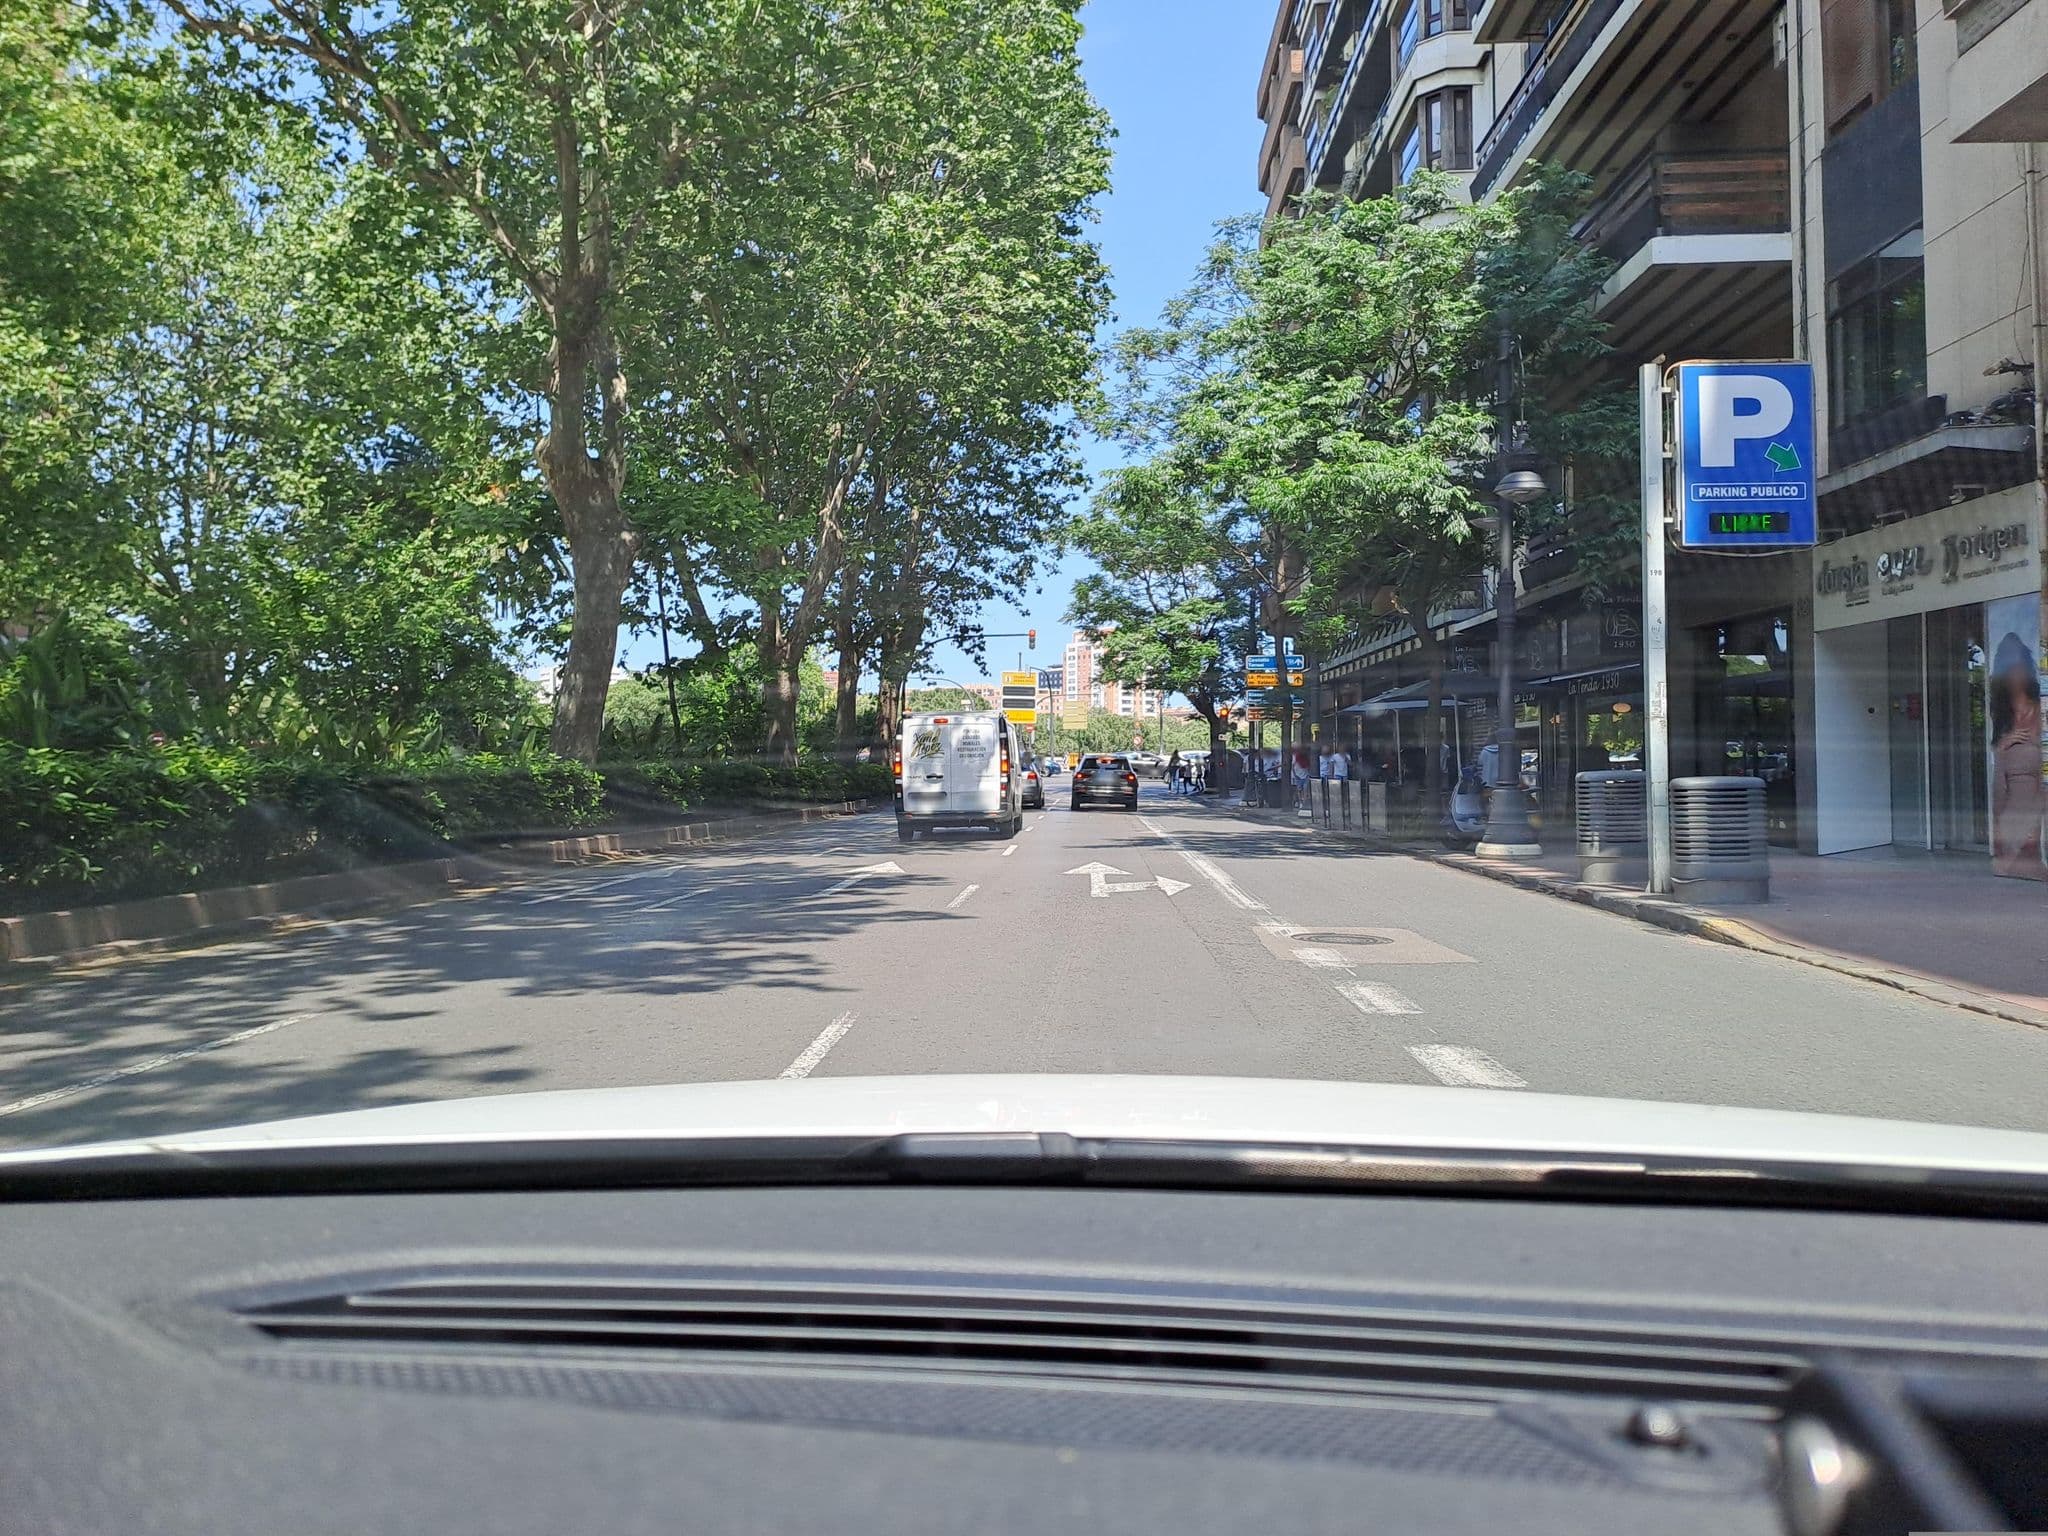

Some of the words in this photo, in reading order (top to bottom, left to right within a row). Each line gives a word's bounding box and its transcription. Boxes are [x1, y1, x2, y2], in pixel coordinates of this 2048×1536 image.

[1699, 375, 1794, 467] P
[1699, 487, 1748, 497] PARKING
[1751, 485, 1799, 497] PUBLICO
[1601, 671, 1619, 690] 1950
